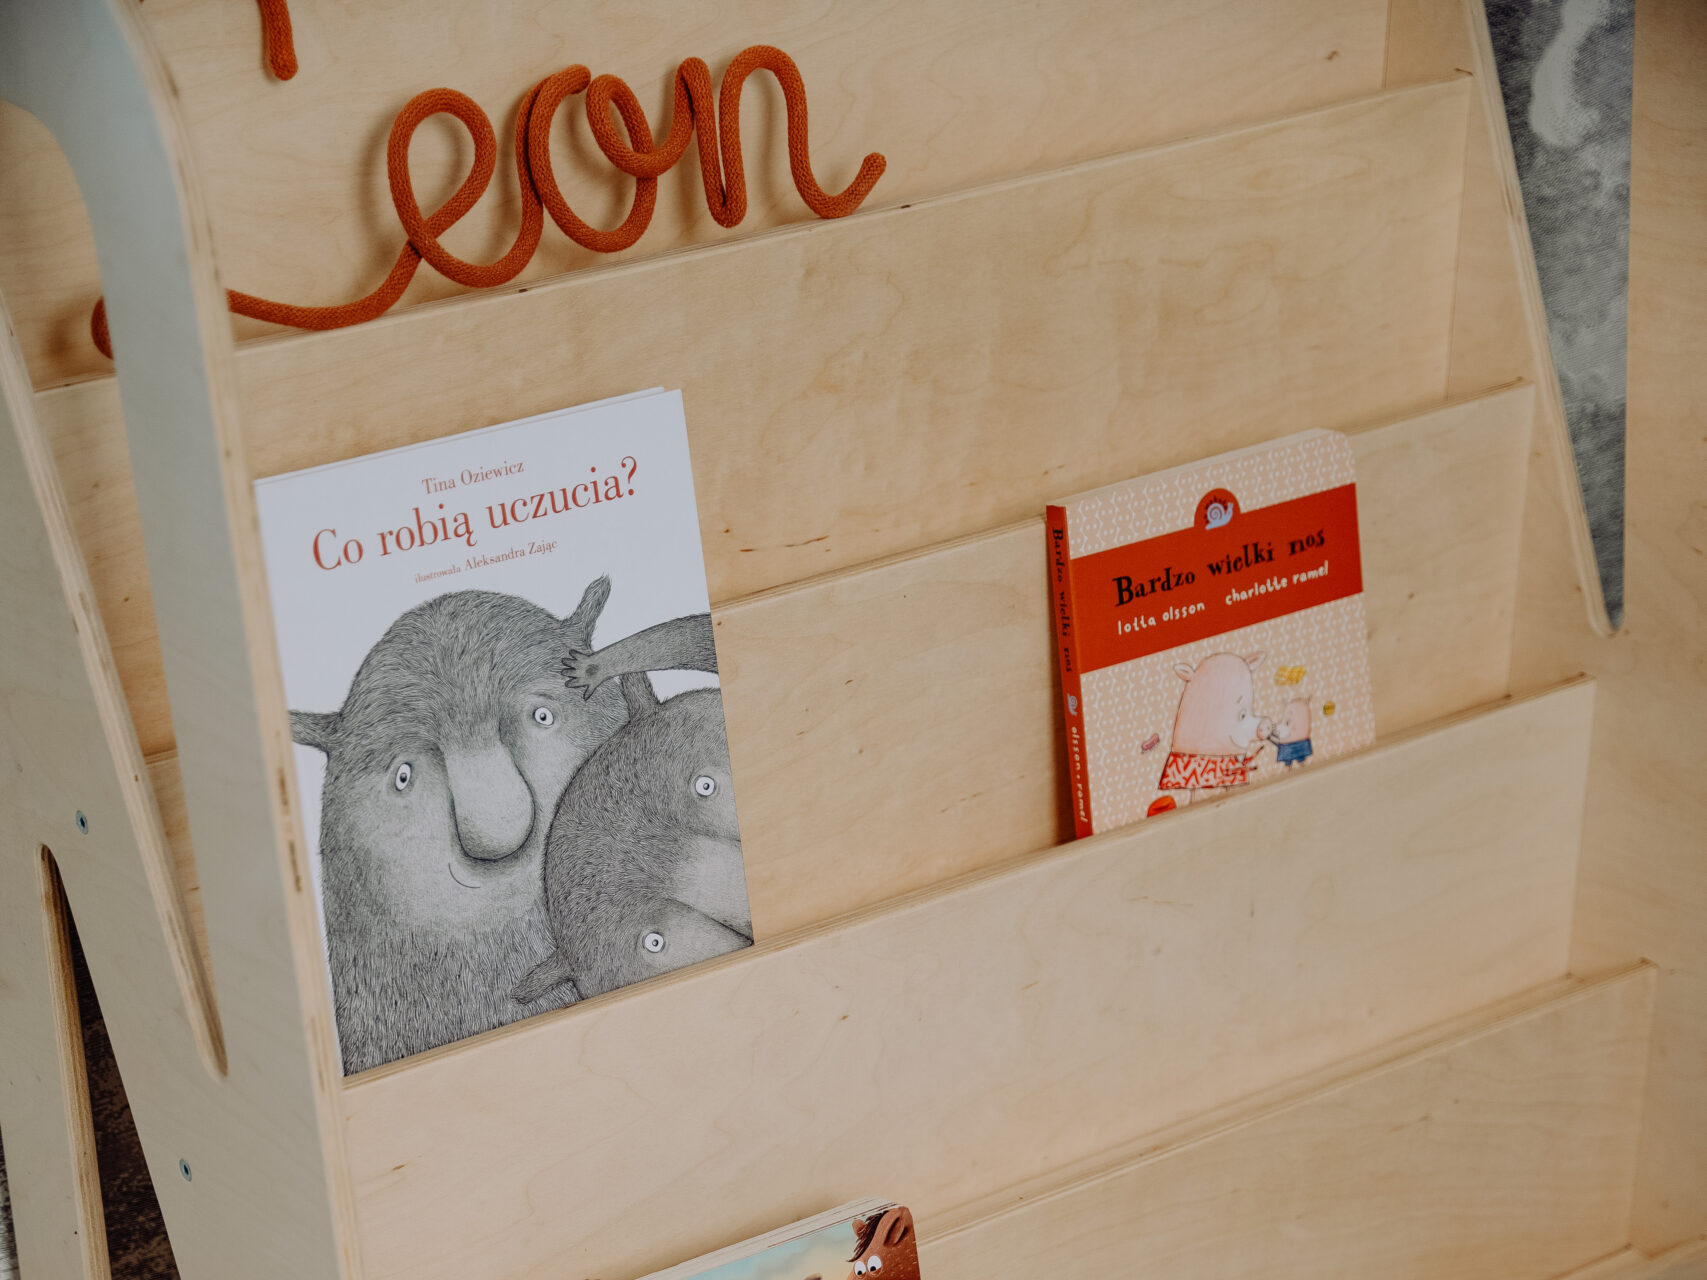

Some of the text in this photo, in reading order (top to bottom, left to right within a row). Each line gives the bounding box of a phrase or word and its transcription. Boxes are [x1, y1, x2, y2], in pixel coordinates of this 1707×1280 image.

[421, 459, 525, 495] Tina Oziewicz
[312, 455, 638, 570] Co robią uczucia?
[464, 547, 526, 571] Aleksandra
[528, 539, 559, 556] Zając
[1111, 528, 1326, 607] Bardzo wielki nos
[1224, 560, 1330, 606] charlotte ramel
[1051, 526, 1074, 673] Bardzo wielki nos
[1117, 601, 1206, 636] lotta olsson
[1070, 726, 1089, 823] olsson ramel
